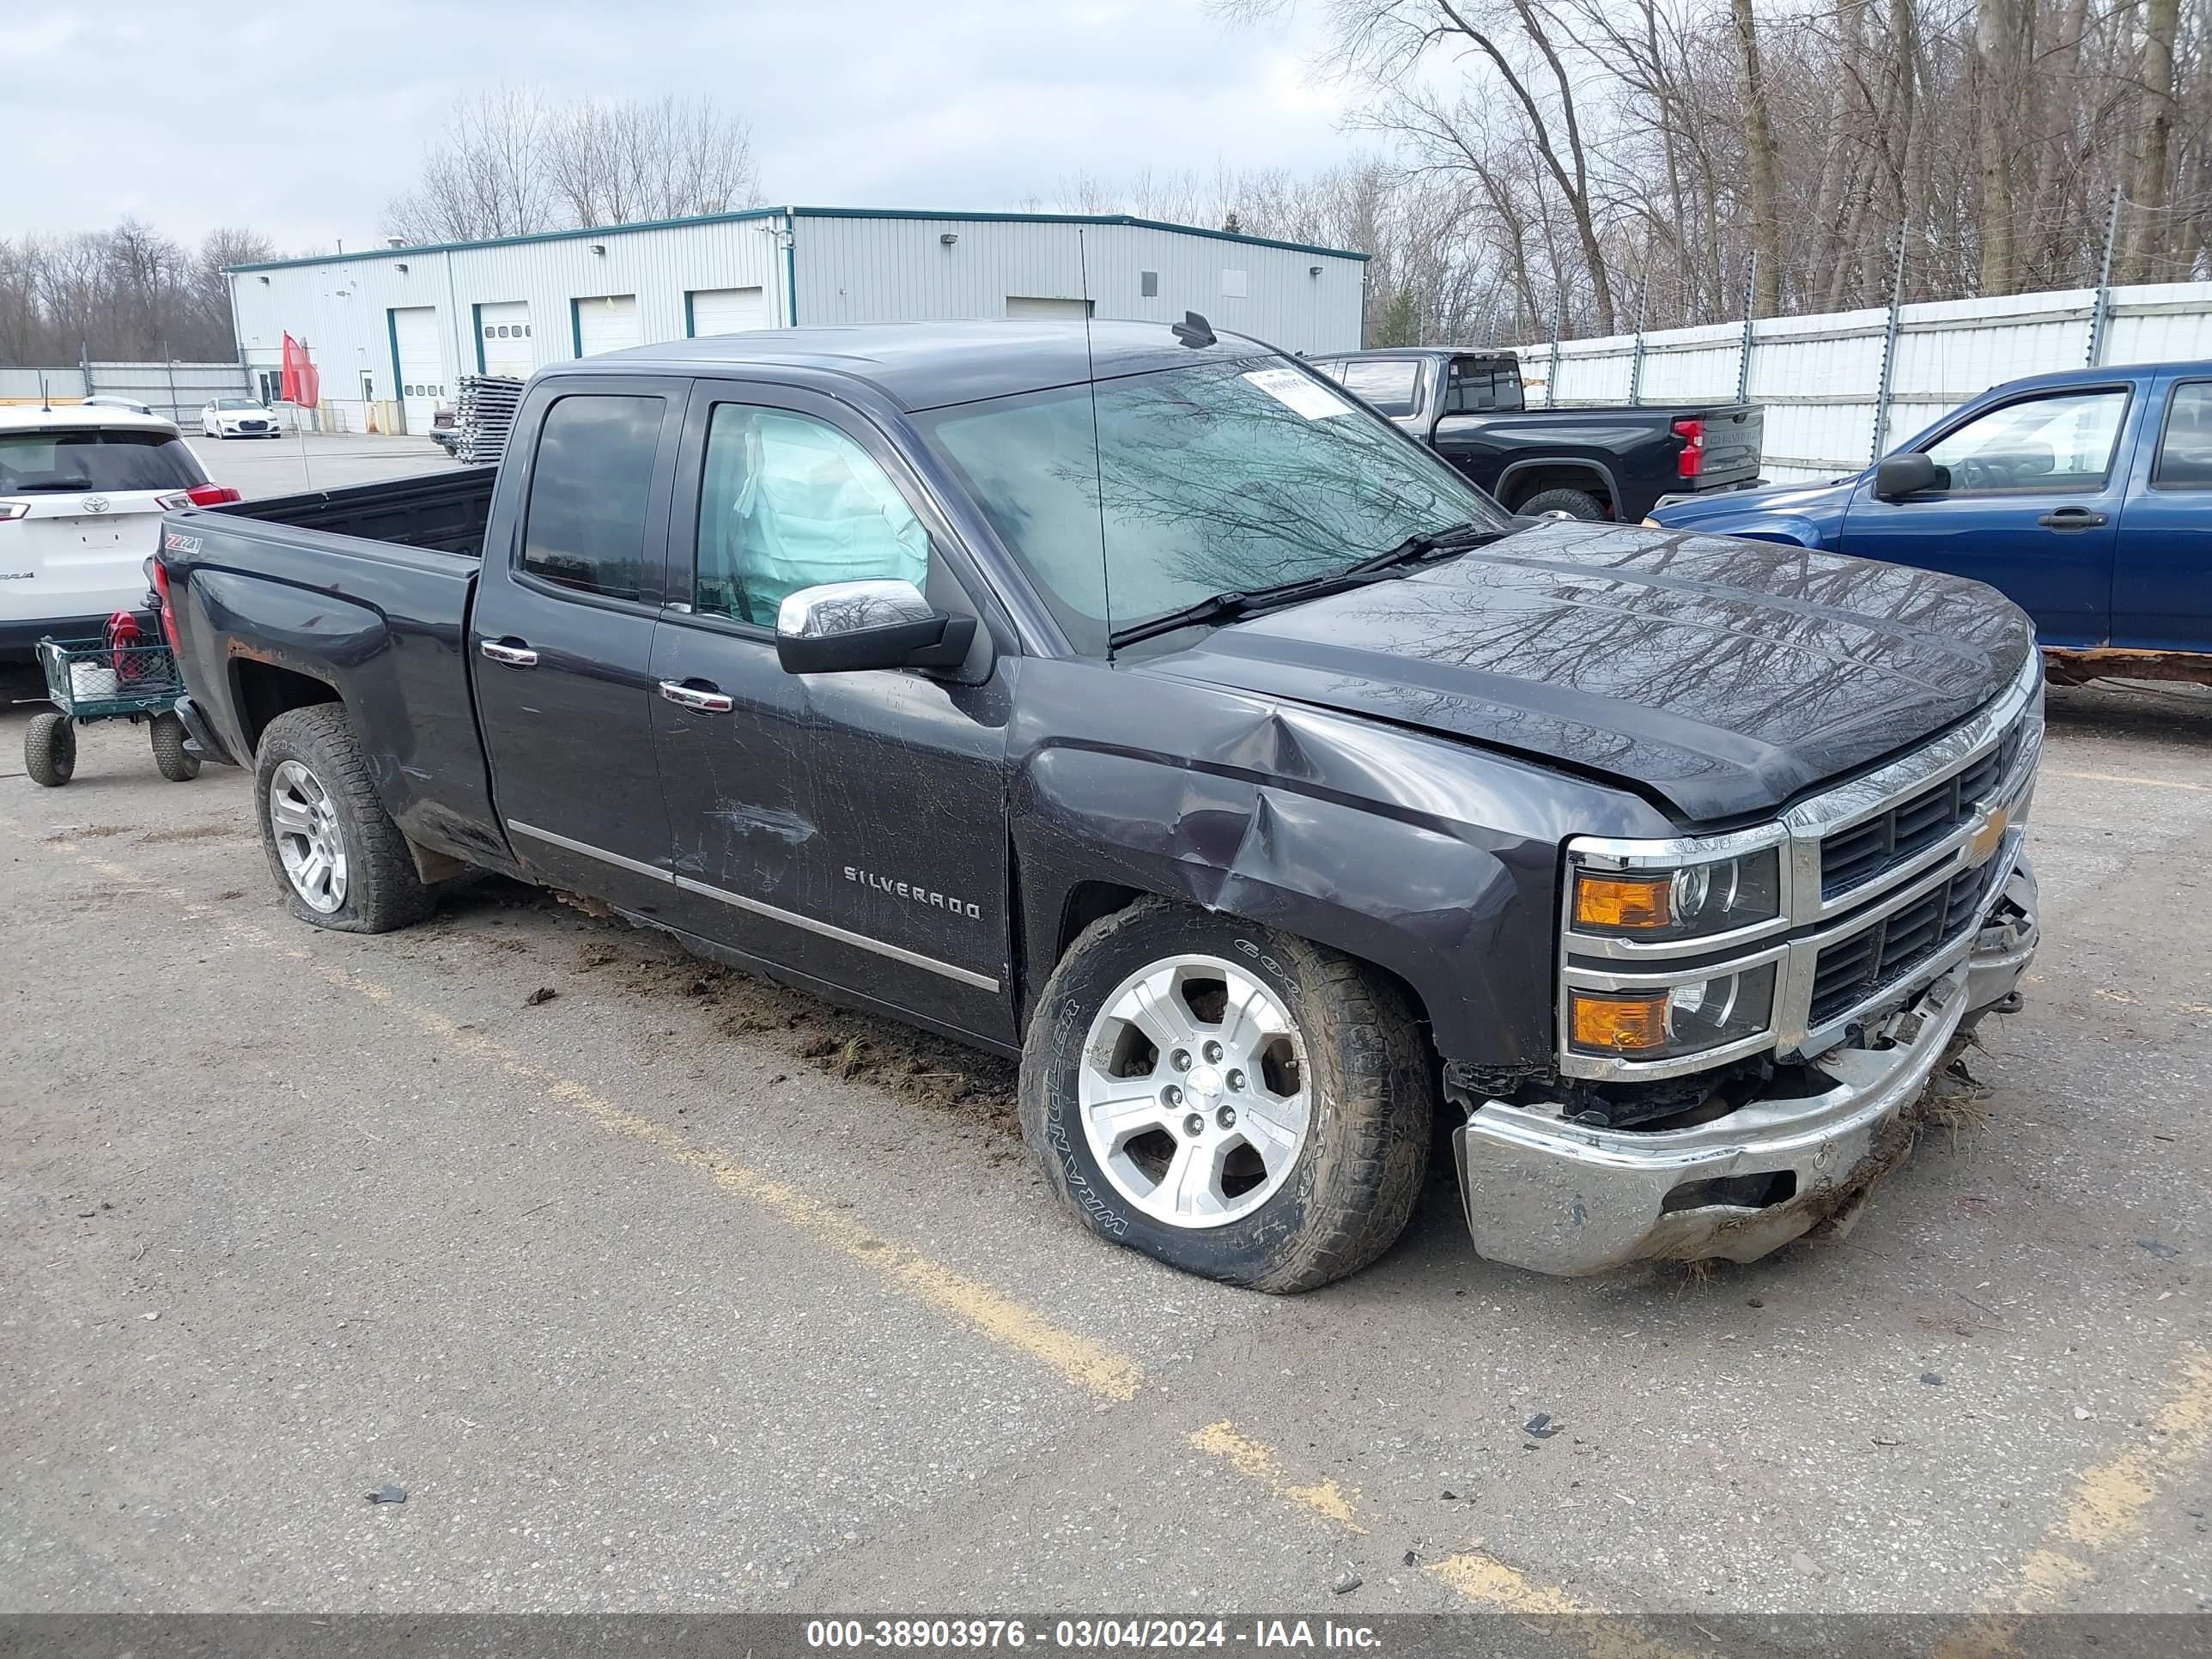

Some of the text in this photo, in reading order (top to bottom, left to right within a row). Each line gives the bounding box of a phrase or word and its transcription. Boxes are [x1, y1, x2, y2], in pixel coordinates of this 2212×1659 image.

[165, 533, 204, 554] Z71
[843, 866, 981, 920] SILVERADO
[1046, 999, 1128, 1236] WRANGLER
